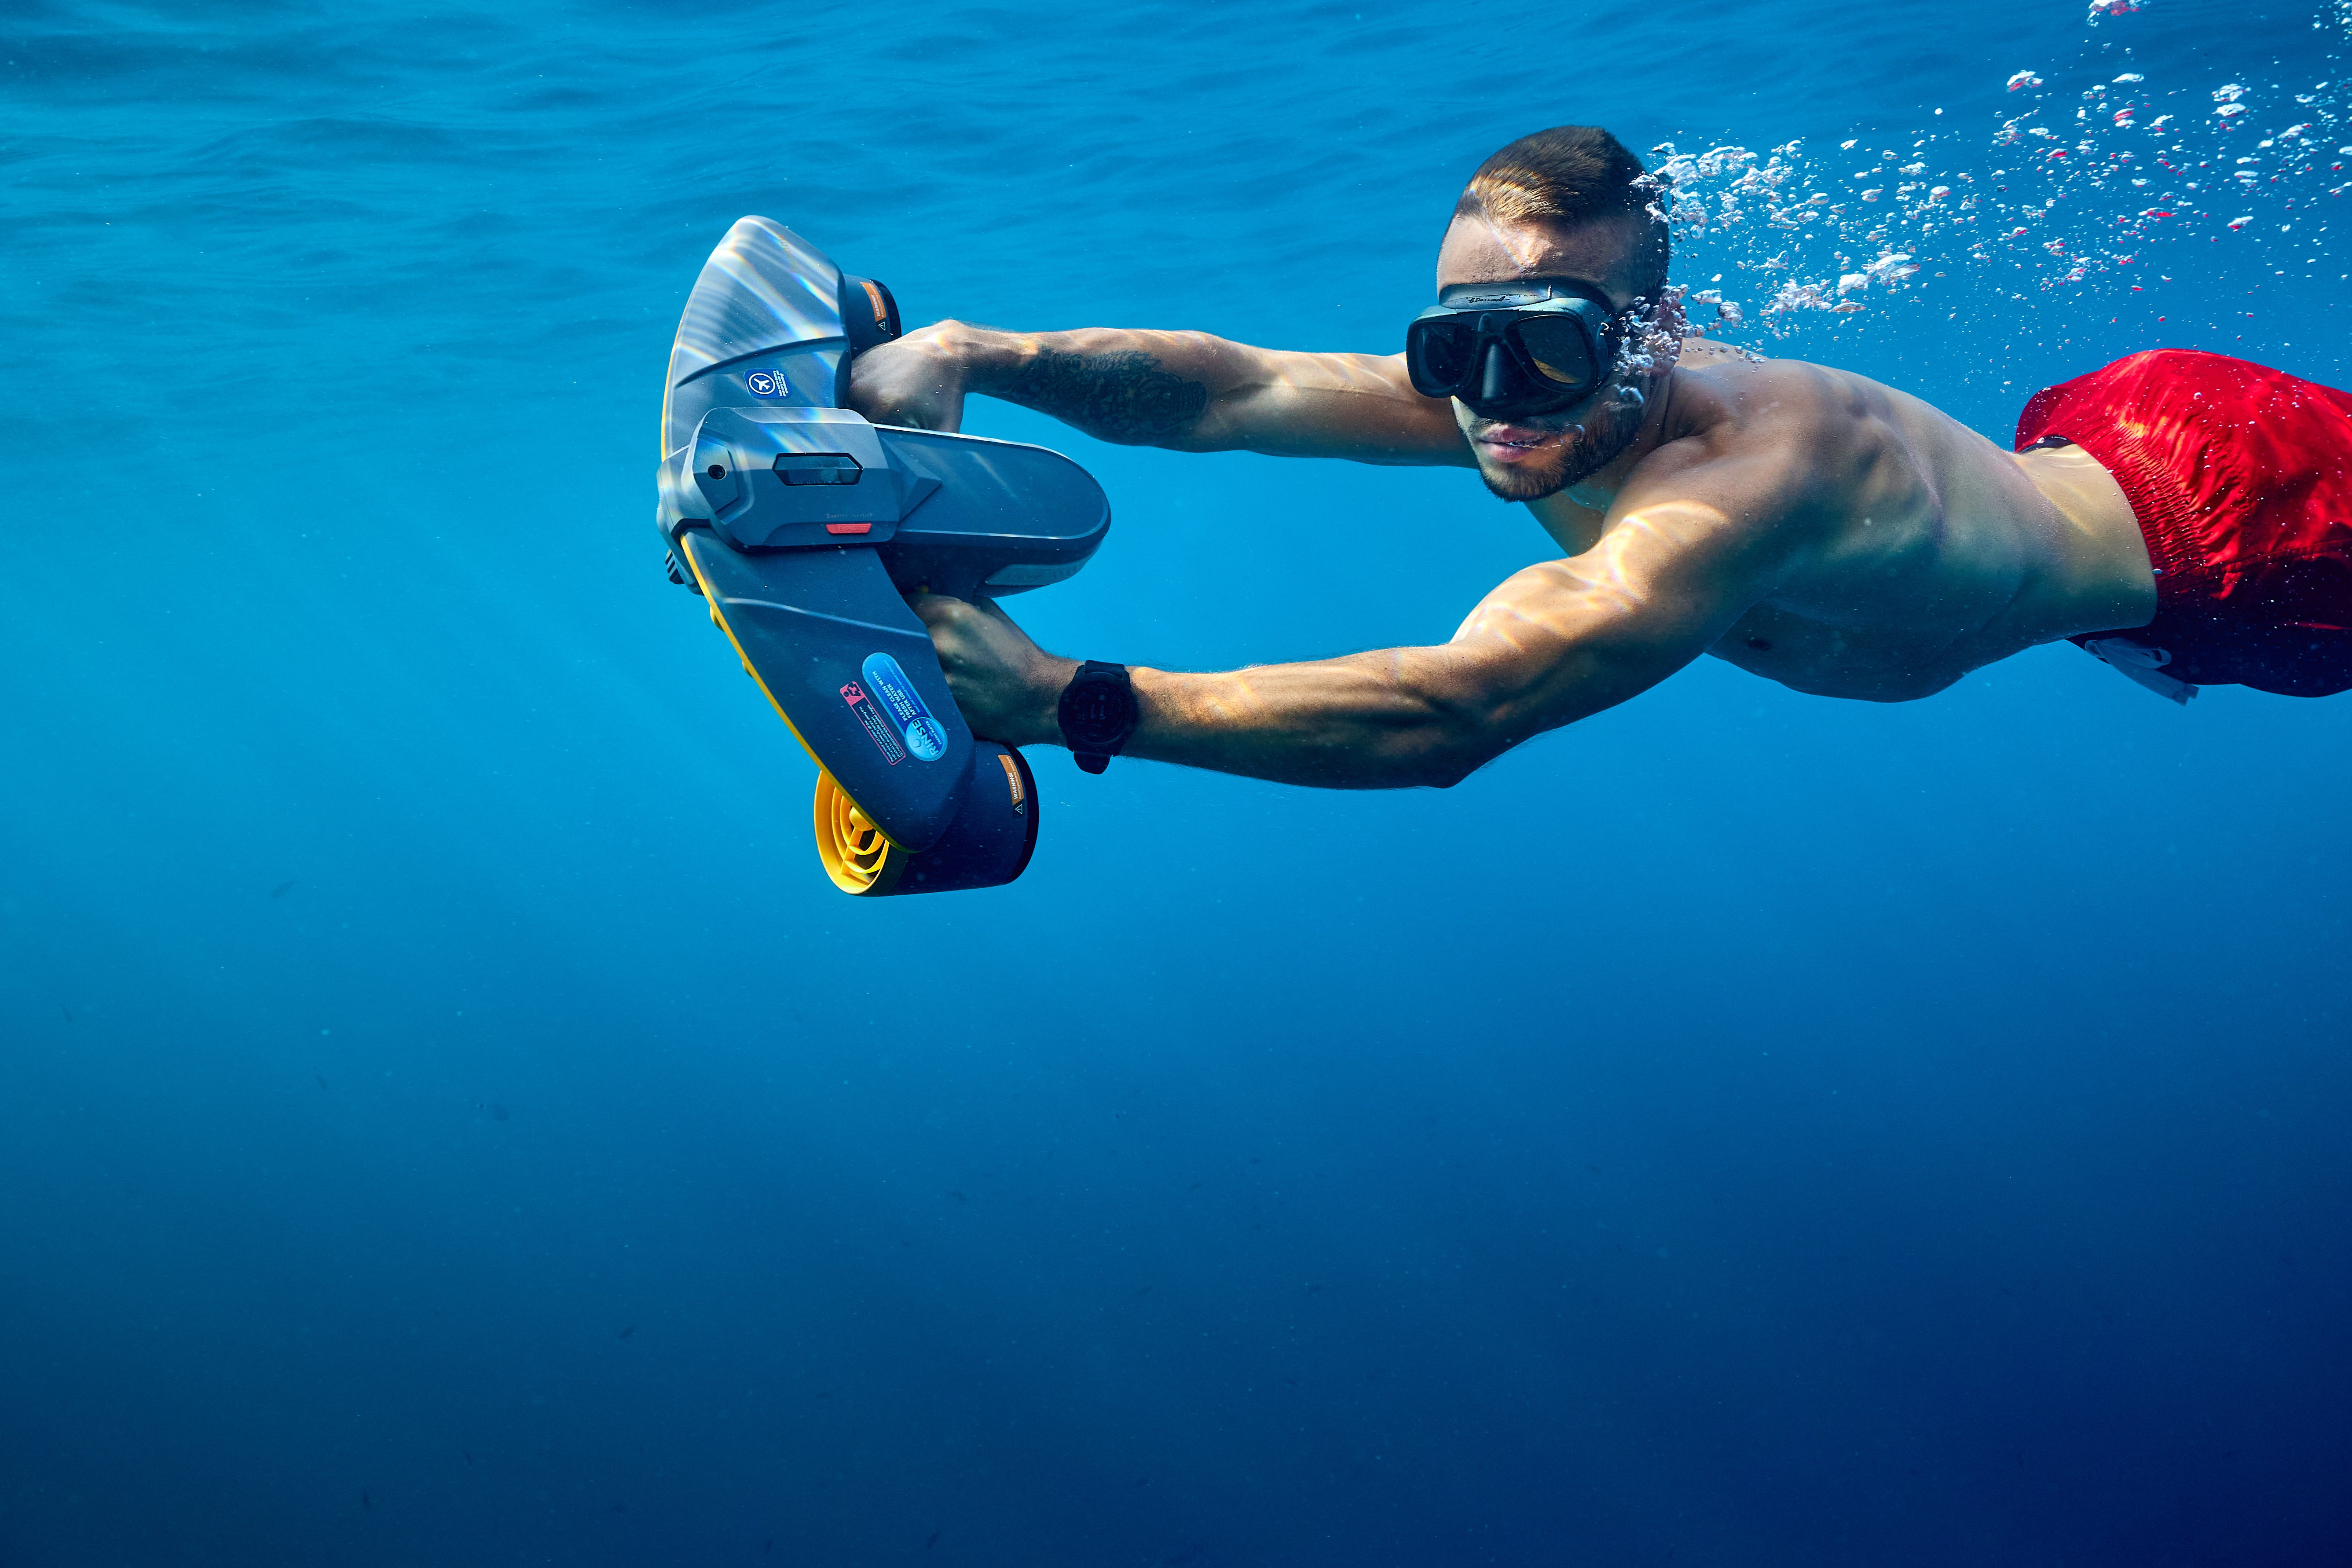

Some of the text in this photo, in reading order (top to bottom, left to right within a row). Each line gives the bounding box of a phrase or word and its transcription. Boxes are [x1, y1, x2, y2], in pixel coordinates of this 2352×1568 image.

[870, 293, 880, 316] WARNING!
[872, 670, 908, 721] PLEASE CLEAN WITH
[887, 683, 912, 718] FRESH WATER
[896, 689, 916, 716] AFTER USE
[911, 719, 939, 756] RINSE
[925, 720, 942, 744] FRESH WATER
[1008, 772, 1018, 799] WARNING!
